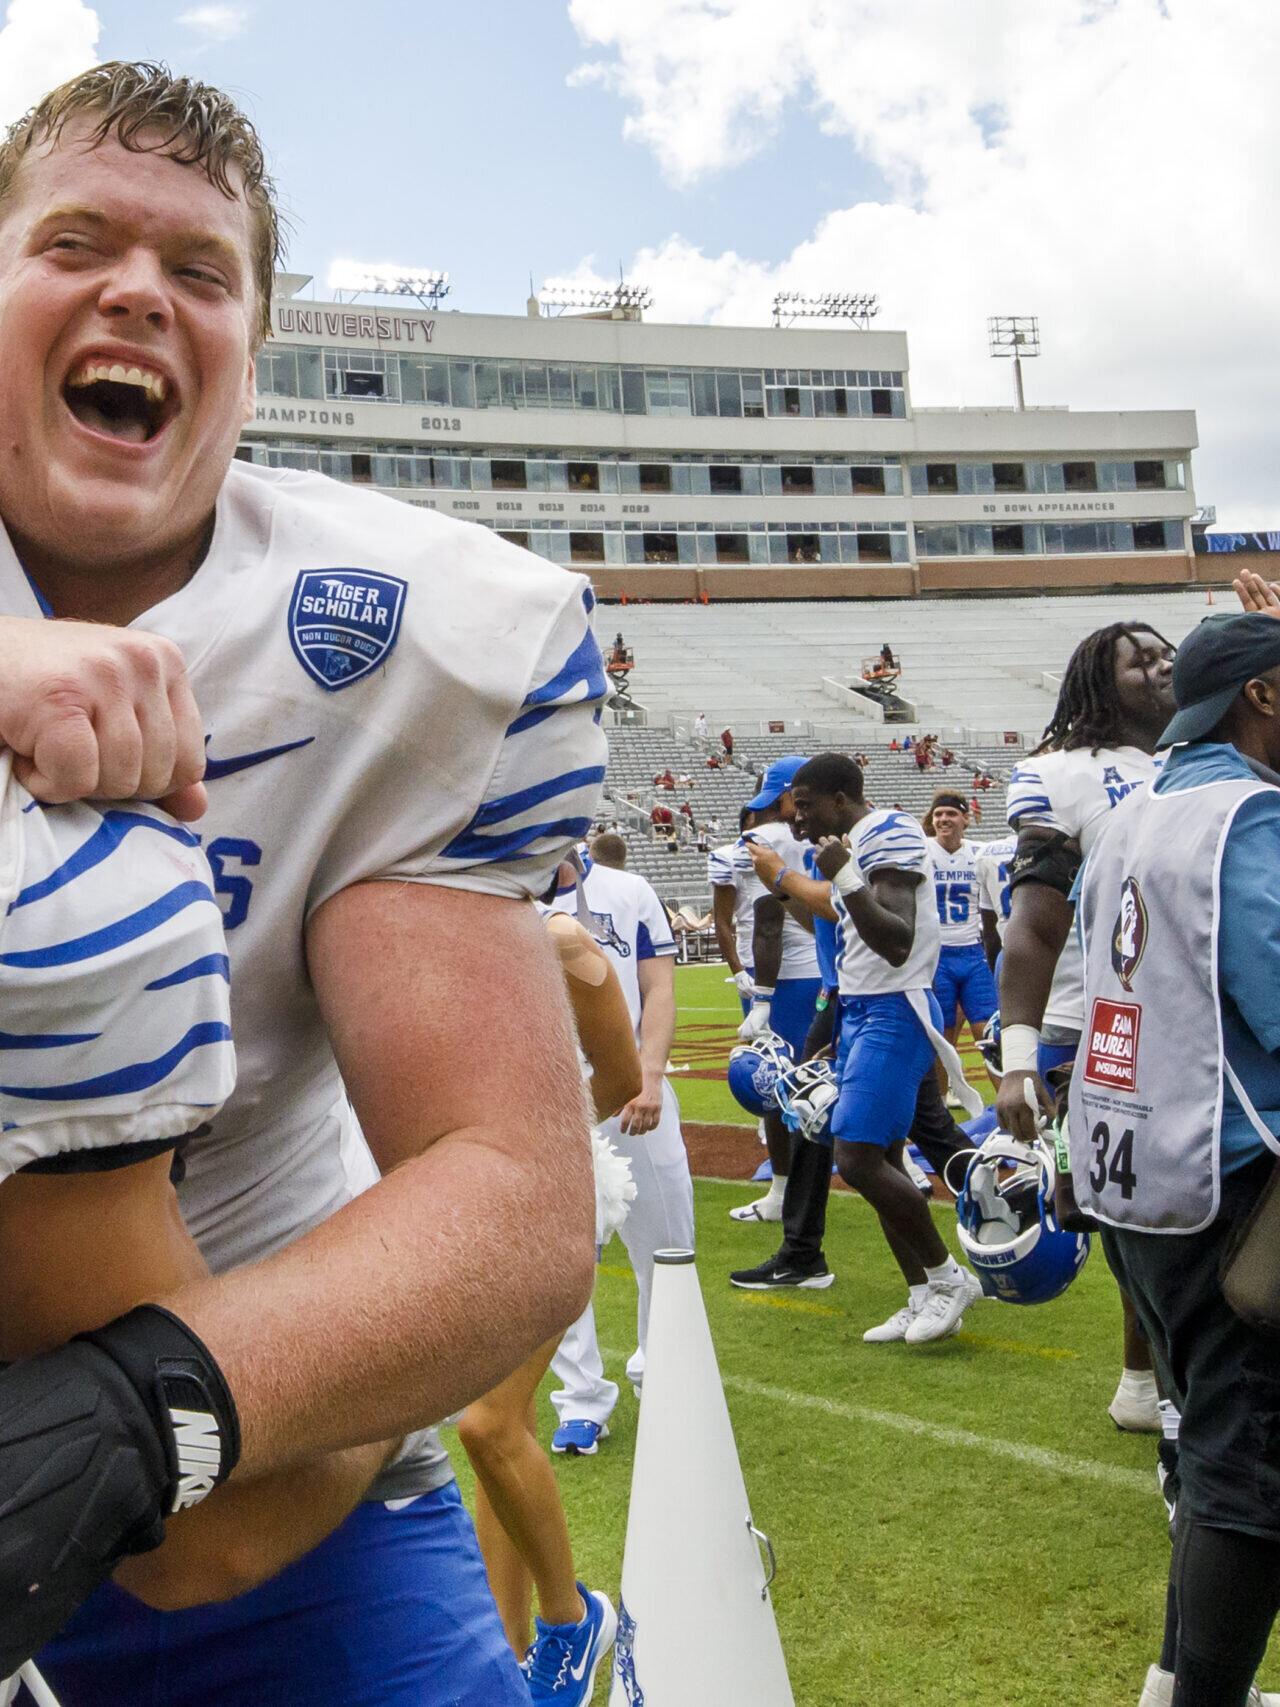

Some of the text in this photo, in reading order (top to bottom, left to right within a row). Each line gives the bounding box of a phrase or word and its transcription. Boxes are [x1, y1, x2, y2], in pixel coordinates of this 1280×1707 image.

[278, 308, 436, 343] UNIVERSITY
[255, 407, 462, 432] HAMPIONS 2013
[580, 504, 606, 513] 2014
[1004, 503, 1034, 513] BOWL
[1037, 502, 1115, 513] APPEARANCES
[320, 579, 380, 605] TIGER
[301, 596, 389, 626] SCHOLAR
[302, 631, 322, 642] NON
[934, 870, 977, 881] MEMPHIS
[935, 883, 972, 924] 15
[1095, 1060, 1132, 1079] INSURANE
[1089, 1120, 1137, 1200] 34
